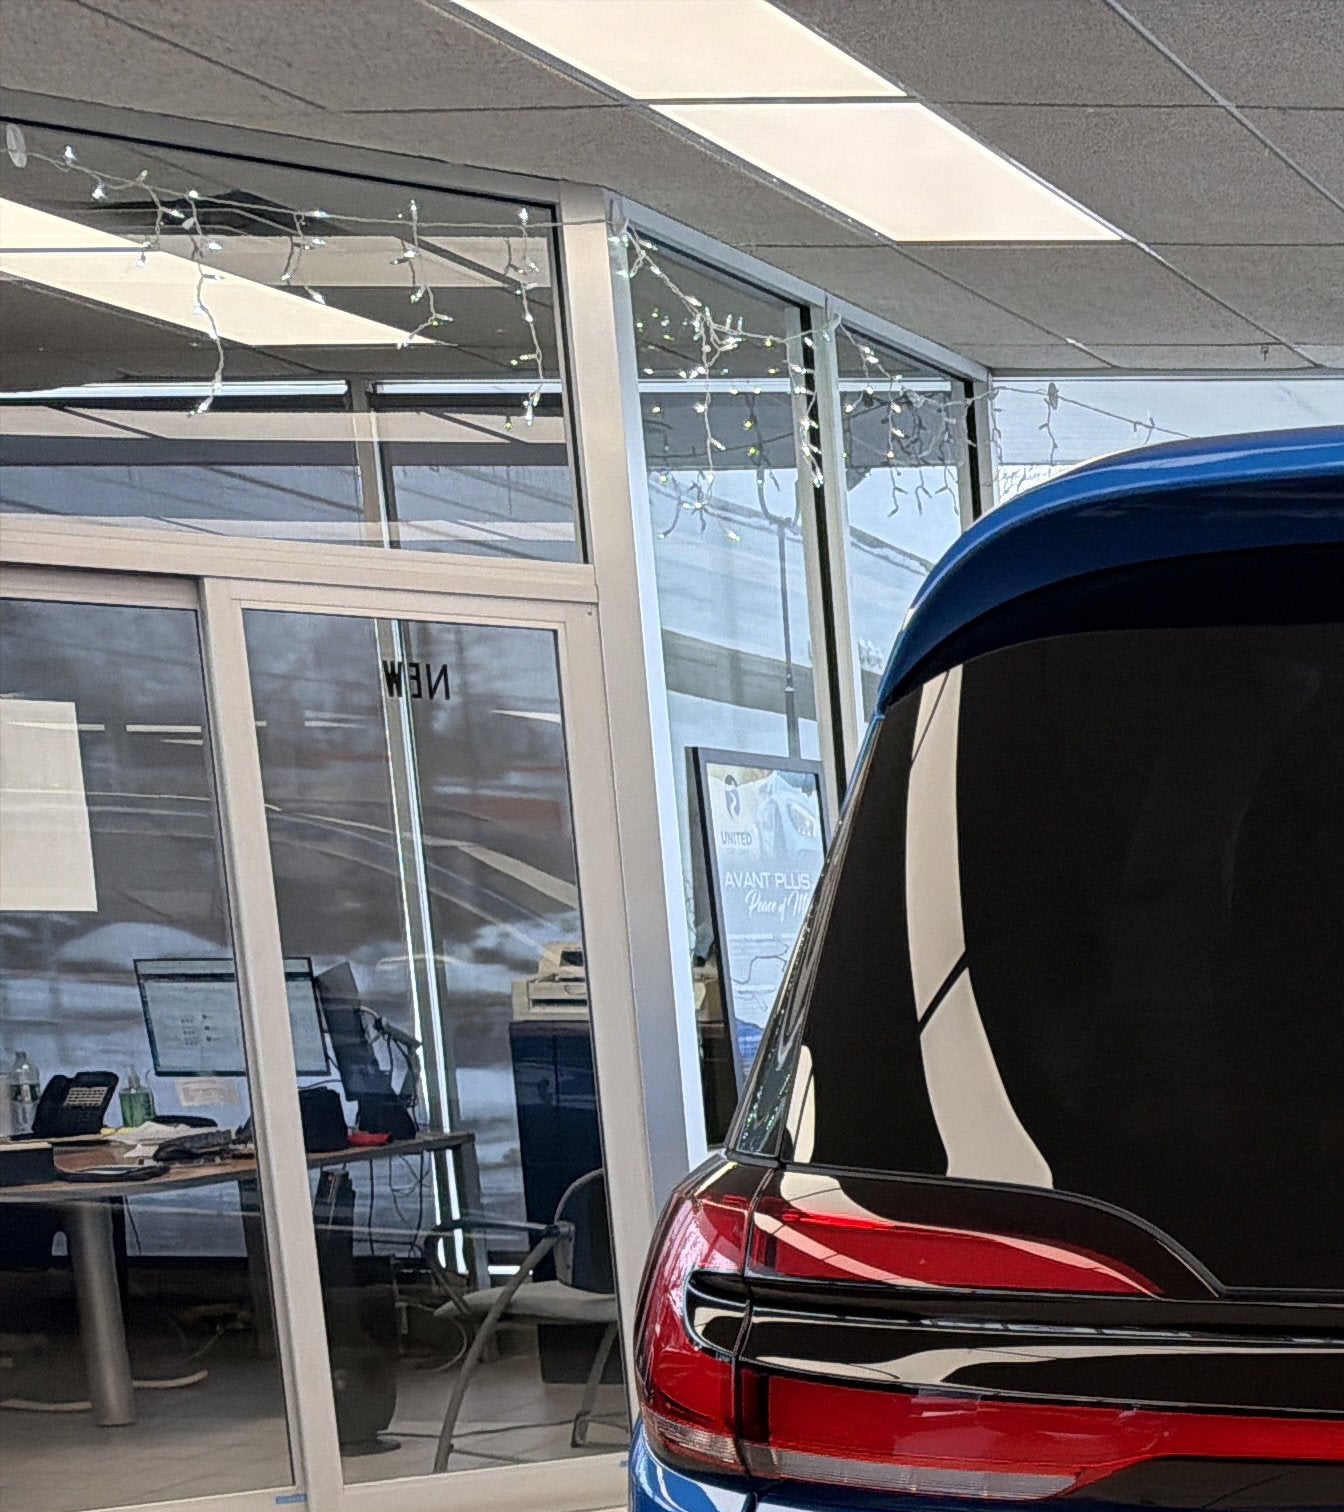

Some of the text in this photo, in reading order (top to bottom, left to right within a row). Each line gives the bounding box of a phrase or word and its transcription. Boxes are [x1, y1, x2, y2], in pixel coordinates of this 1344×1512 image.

[721, 831, 752, 846] UNITED
[724, 872, 811, 890] AVANT PLUS
[745, 889, 778, 918] Peace
